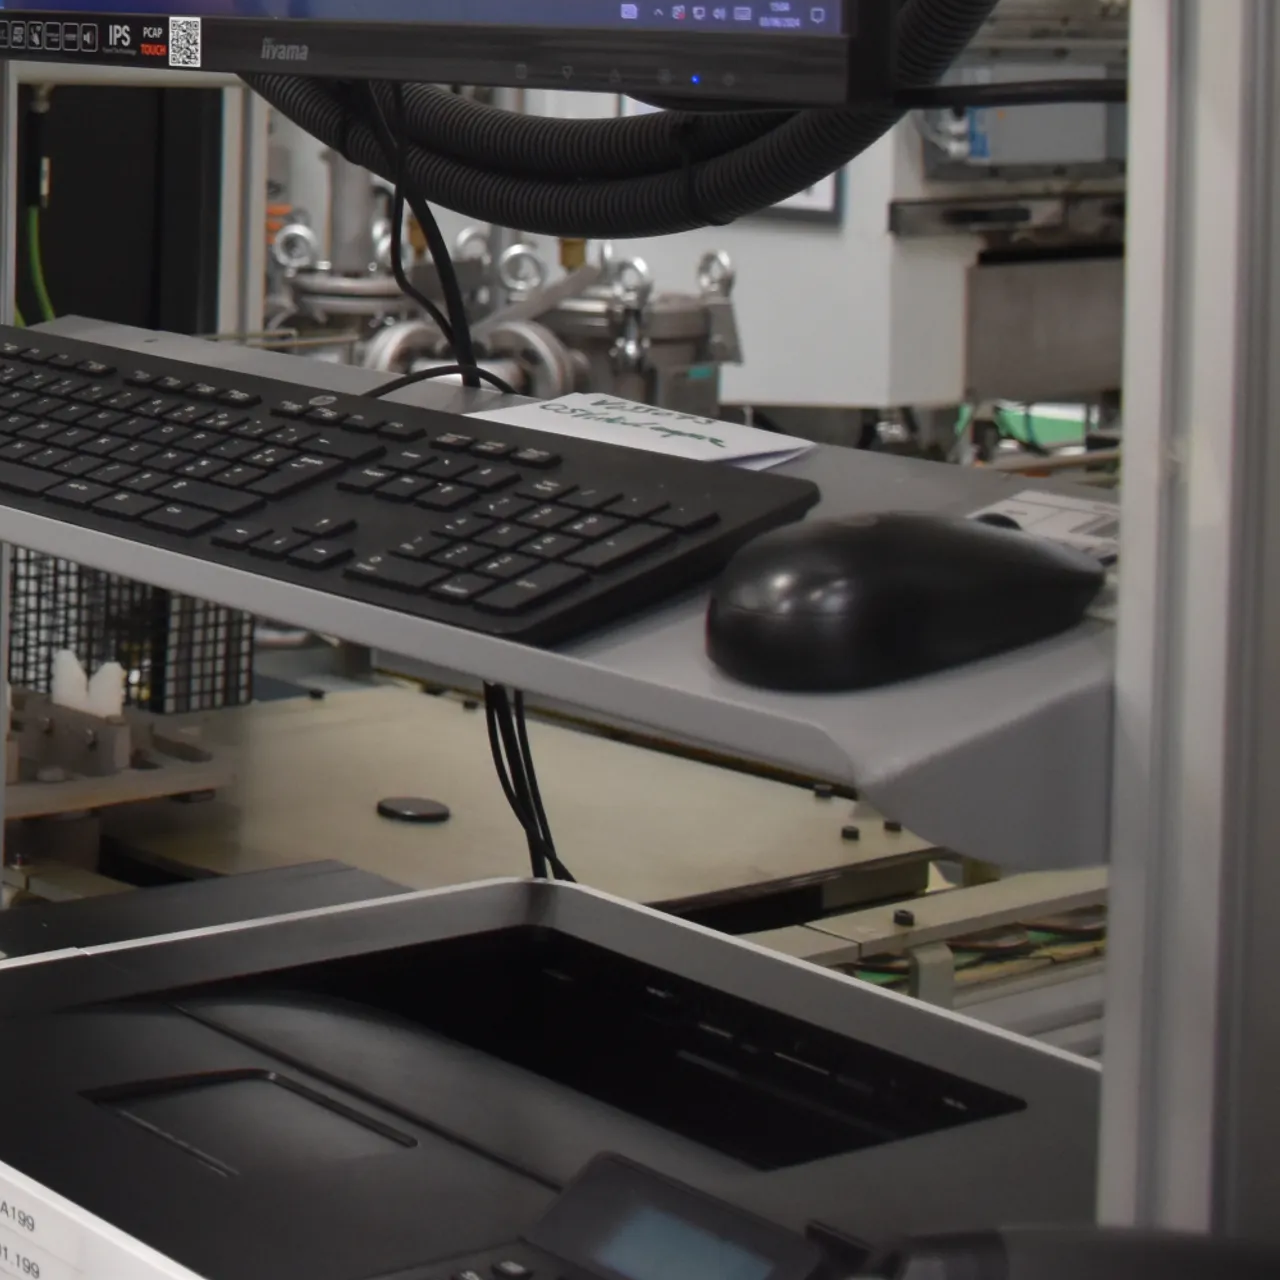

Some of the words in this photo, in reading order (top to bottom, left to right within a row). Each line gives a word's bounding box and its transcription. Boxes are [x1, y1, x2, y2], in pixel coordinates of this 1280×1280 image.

[109, 24, 131, 47] IPS
[143, 26, 163, 39] PCAP
[141, 43, 167, 56] TOUCH
[260, 37, 309, 61] iiyama
